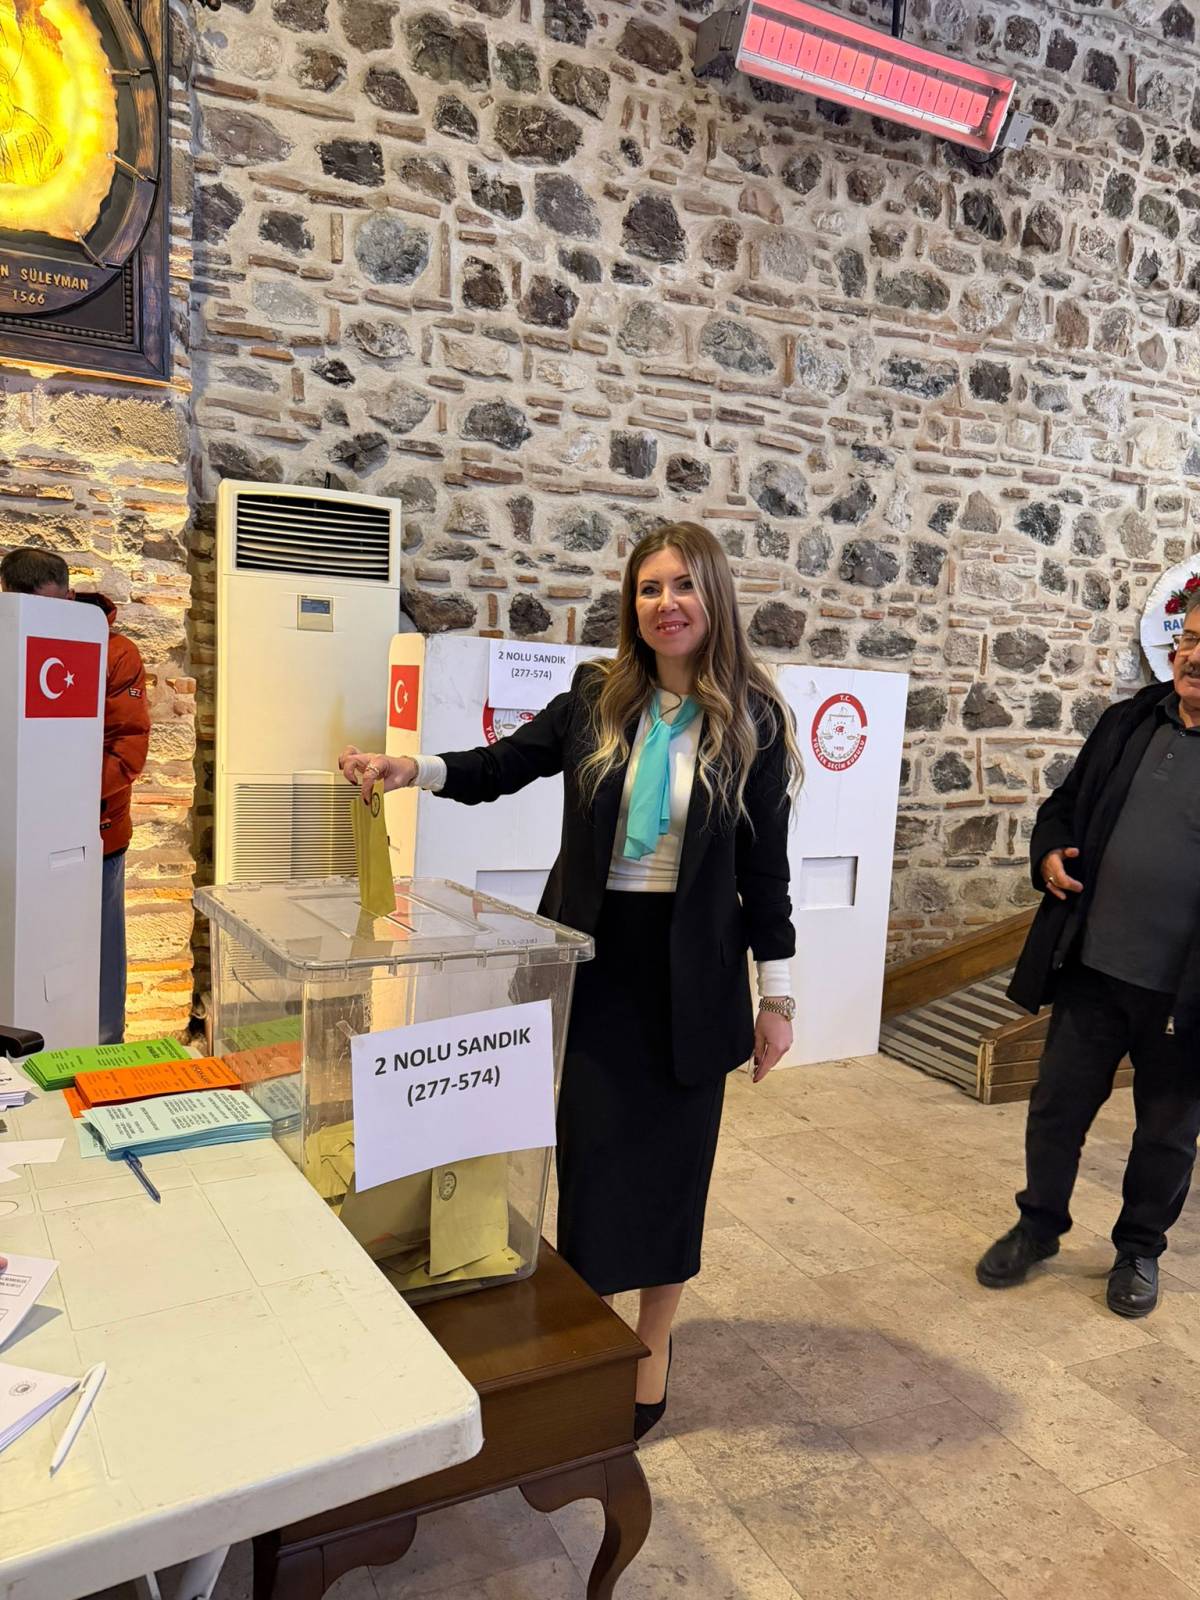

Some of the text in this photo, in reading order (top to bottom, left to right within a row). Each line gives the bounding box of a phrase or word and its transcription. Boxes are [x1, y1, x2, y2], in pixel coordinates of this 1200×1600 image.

[20, 267, 89, 291] SÜLEYMAN
[13, 289, 46, 305] 1566
[498, 651, 566, 664] 2 NOLU SANDIK
[511, 668, 552, 680] (277-574)
[374, 1027, 531, 1076] 2 NOLU SANDIK
[407, 1065, 501, 1107] (277-574)
